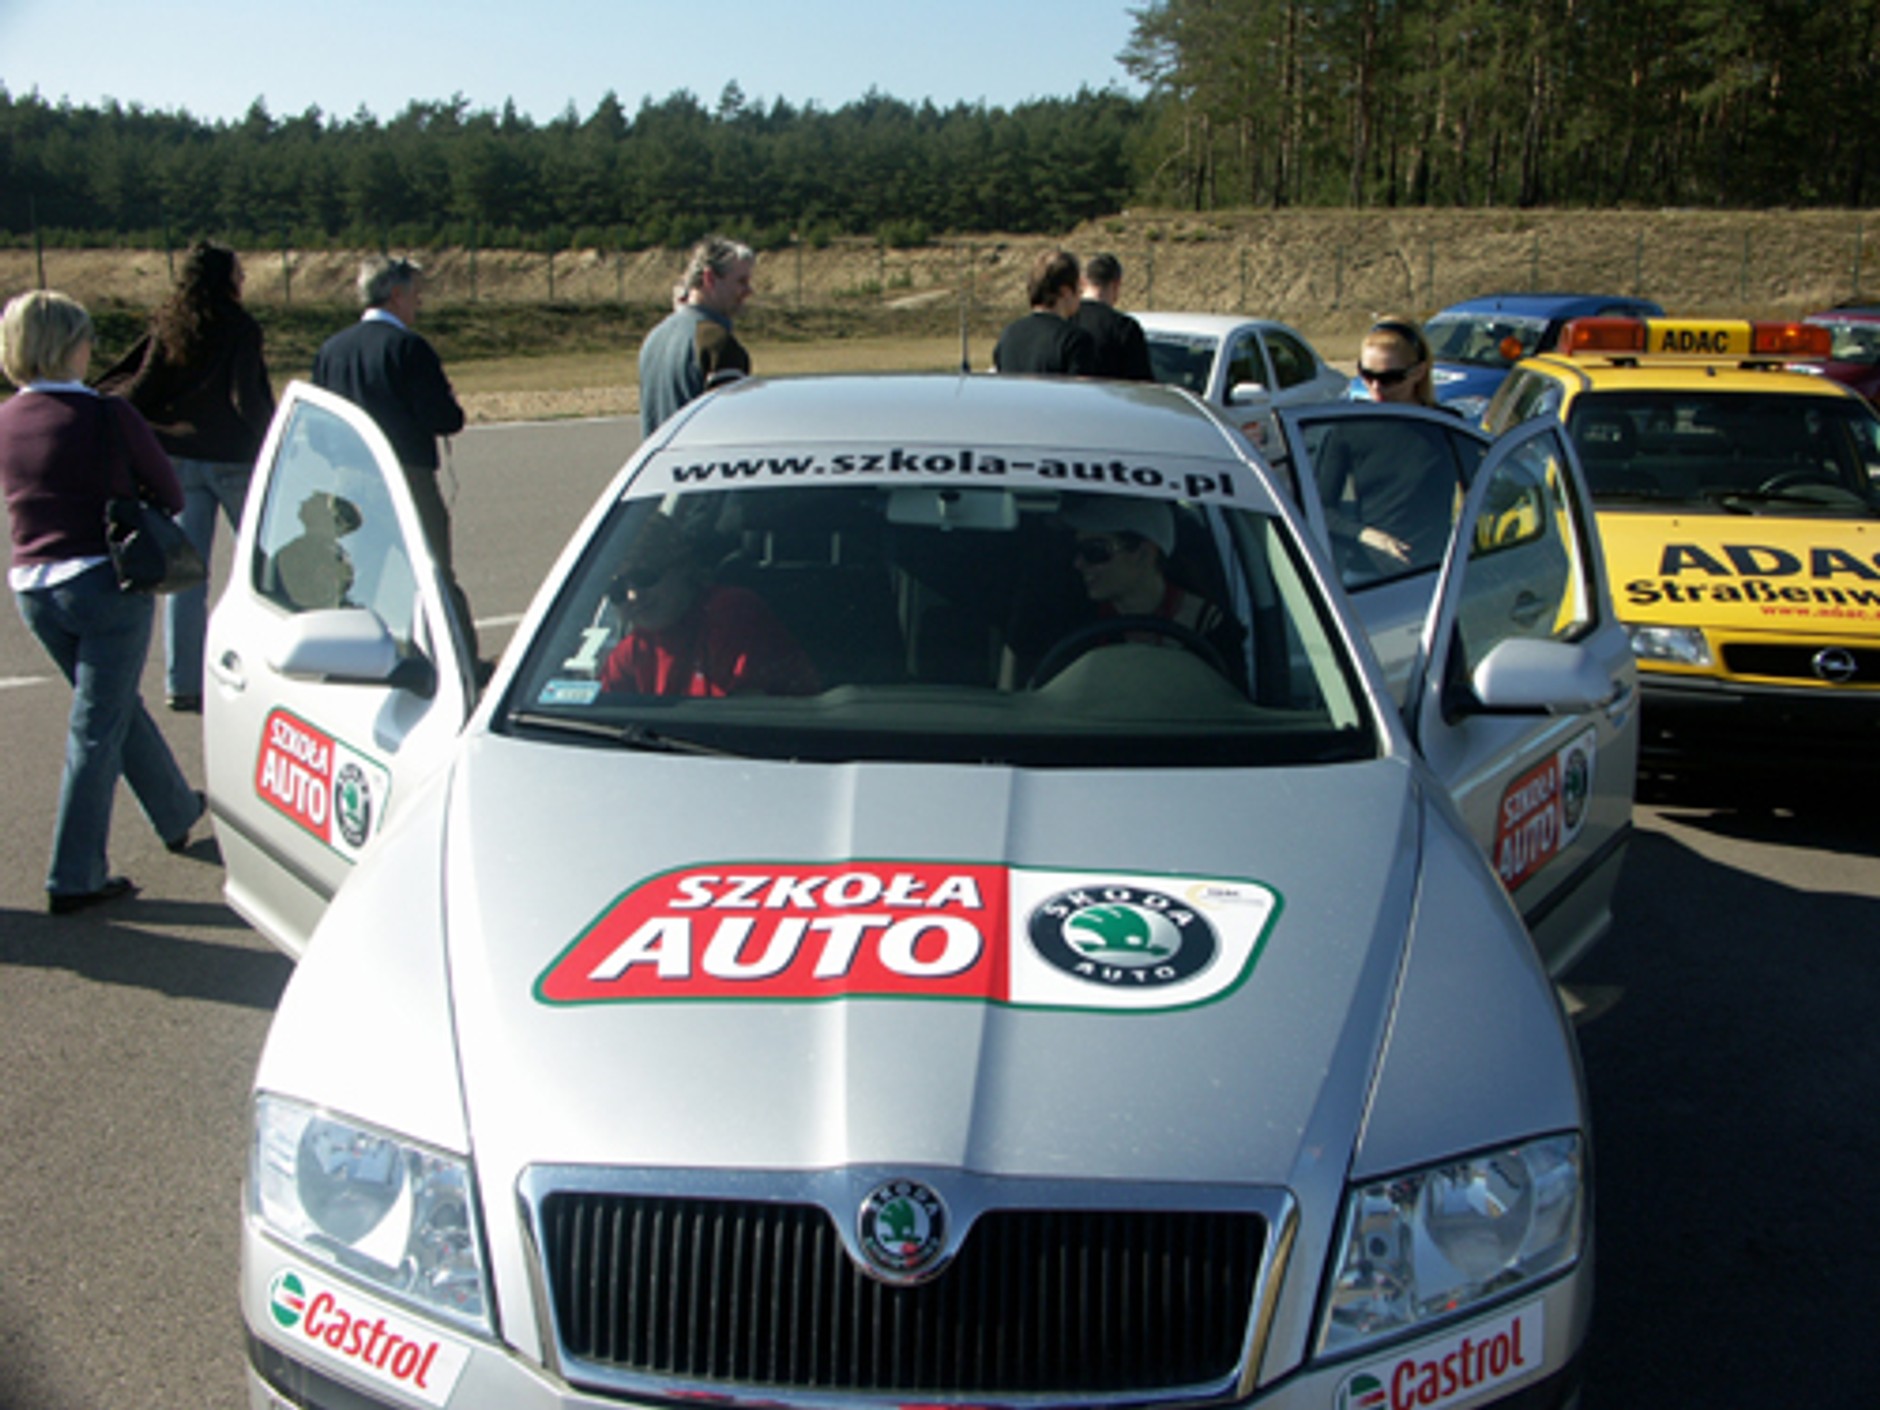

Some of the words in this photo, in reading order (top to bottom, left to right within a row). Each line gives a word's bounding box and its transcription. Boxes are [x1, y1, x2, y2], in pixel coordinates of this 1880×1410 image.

[1661, 328, 1730, 354] ADAC
[671, 448, 1236, 498] www.szkola-auto.pl
[1659, 543, 1880, 581] ADA
[261, 746, 326, 827] AUTO
[1499, 801, 1557, 882] AUTO
[666, 871, 985, 909] SZKOŁA
[586, 913, 987, 982] AUTO
[1074, 961, 1176, 983] AUTO
[302, 1291, 440, 1390] Castrol
[1391, 1315, 1525, 1410] Castrol
